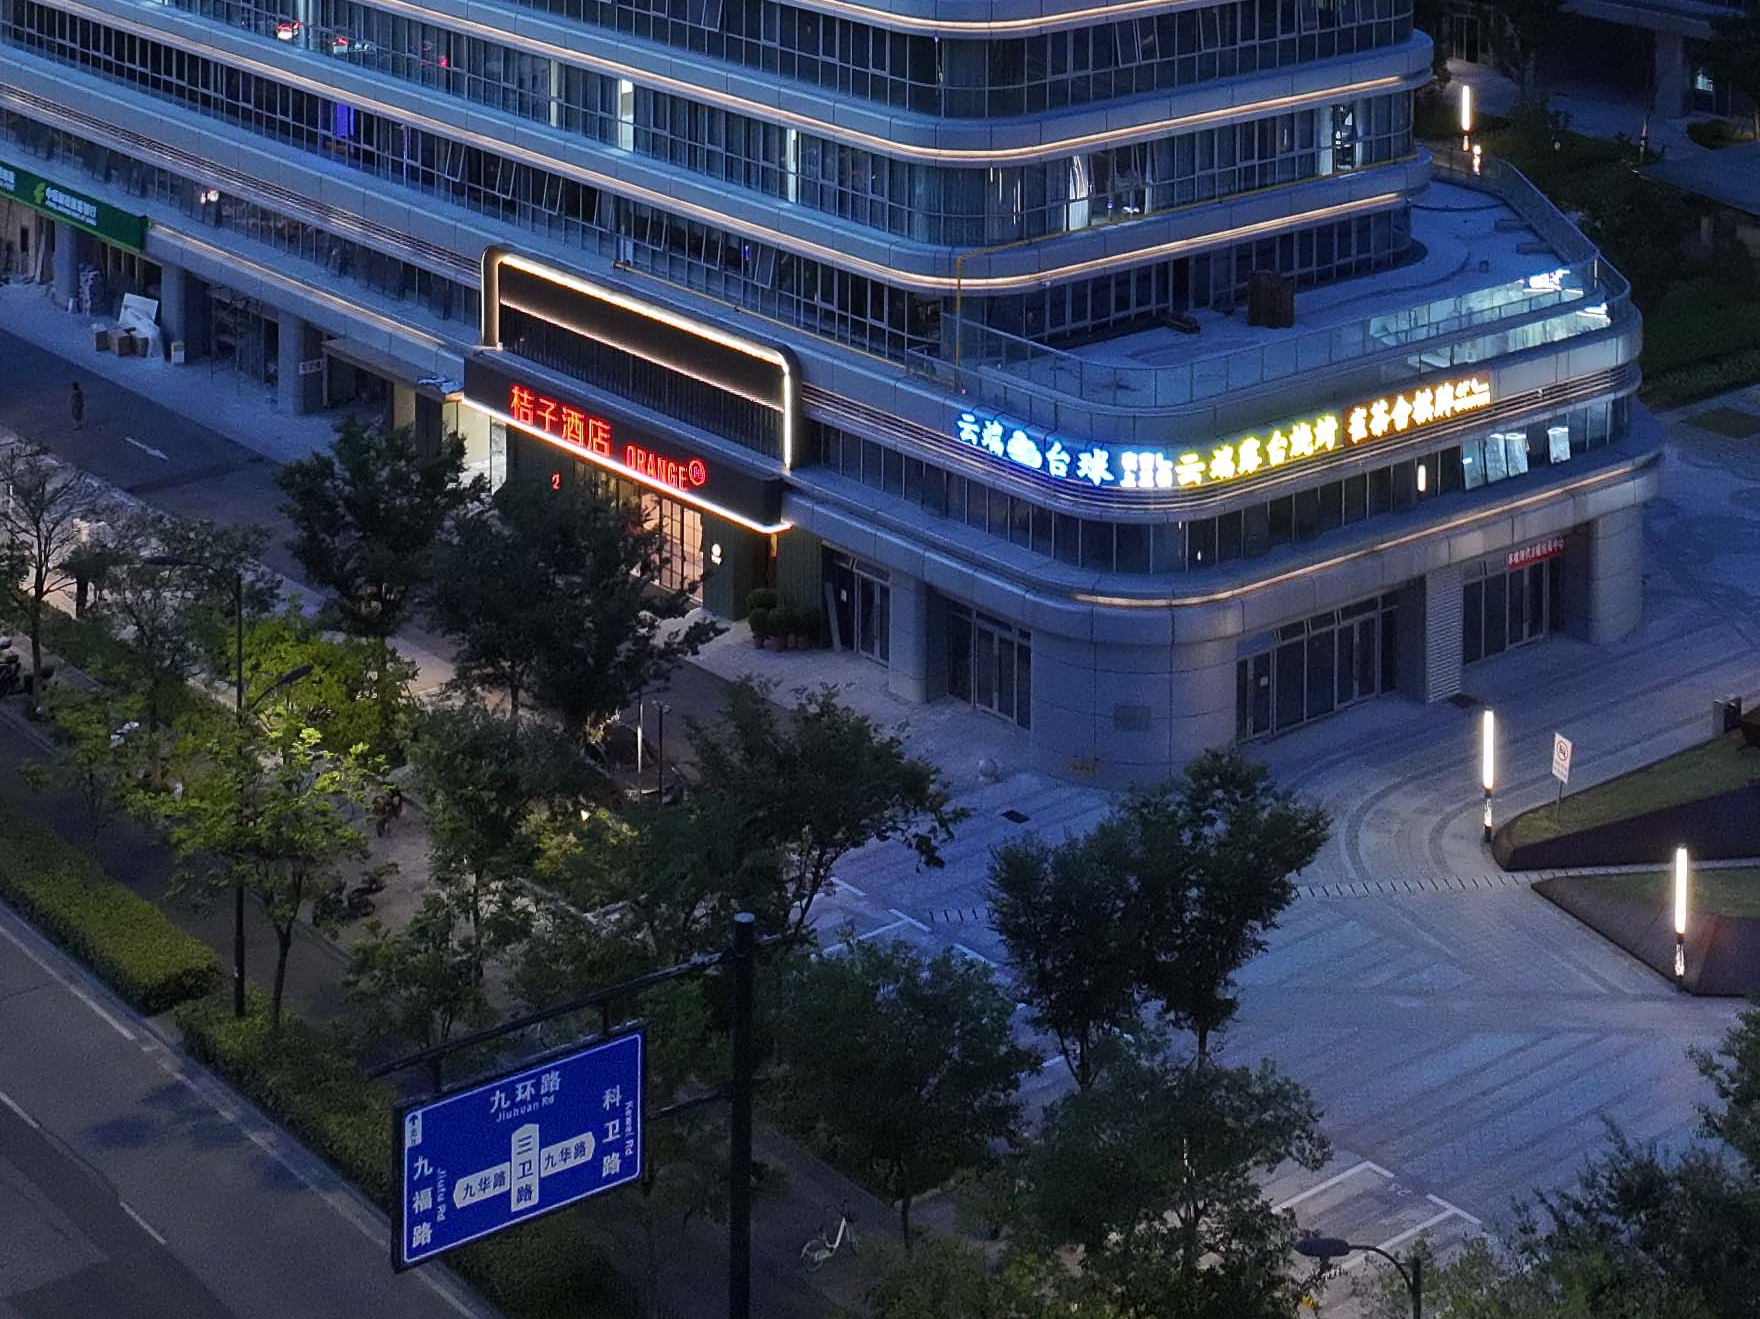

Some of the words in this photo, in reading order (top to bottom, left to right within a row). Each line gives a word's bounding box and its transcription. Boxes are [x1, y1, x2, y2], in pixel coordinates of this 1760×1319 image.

[510, 385, 610, 459] 桔子酒店
[626, 444, 688, 492] ORANGE
[1045, 441, 1115, 486] 台球
[490, 1070, 561, 1114] 九环路
[495, 1101, 540, 1123] Jiuhuan
[541, 1094, 555, 1109] Rd
[602, 1084, 622, 1179] 科卫路
[624, 1139, 634, 1156] Rd
[516, 1134, 533, 1204] 三卫路
[544, 1140, 586, 1171] 九华路
[411, 1155, 433, 1249] 九福路
[462, 1170, 506, 1201] 九华路
[436, 1204, 447, 1222] Rd
